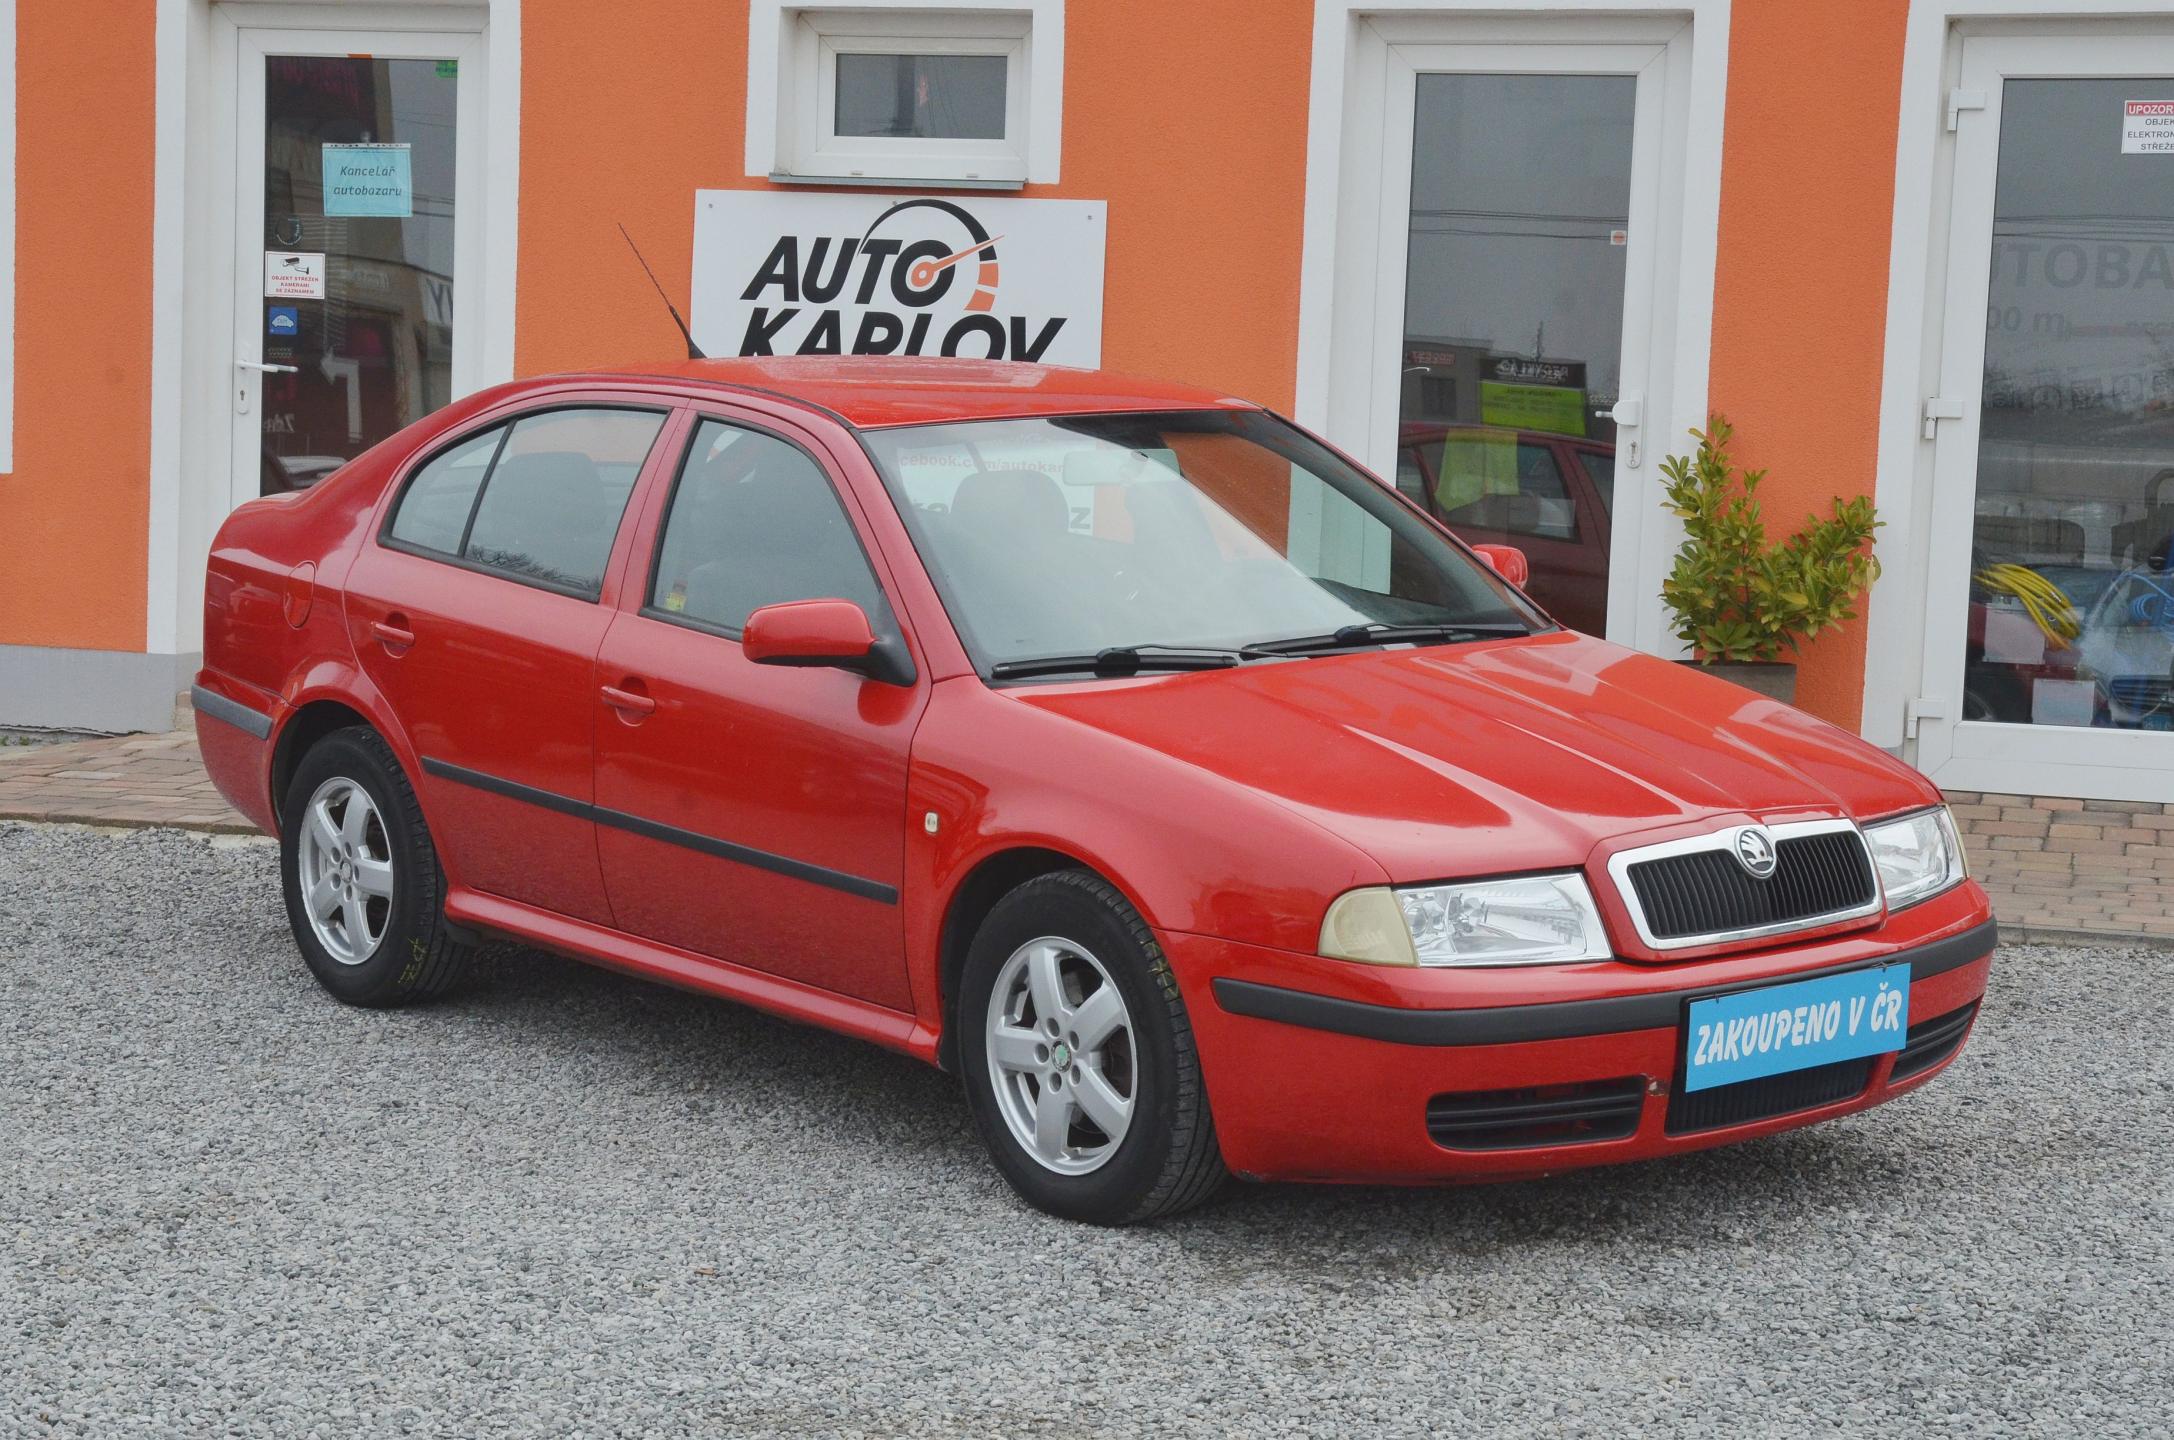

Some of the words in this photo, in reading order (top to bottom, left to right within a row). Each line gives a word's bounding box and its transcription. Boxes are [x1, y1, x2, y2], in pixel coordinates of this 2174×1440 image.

[2128, 104, 2174, 115] UPOZOR
[333, 186, 402, 196] autobazaru
[740, 235, 956, 308] AUTO
[738, 307, 1067, 363] KARLOV
[1694, 1000, 1841, 1066] ZAKOUPENO
[1849, 996, 1866, 1036] V
[1870, 982, 1902, 1032] ČR
